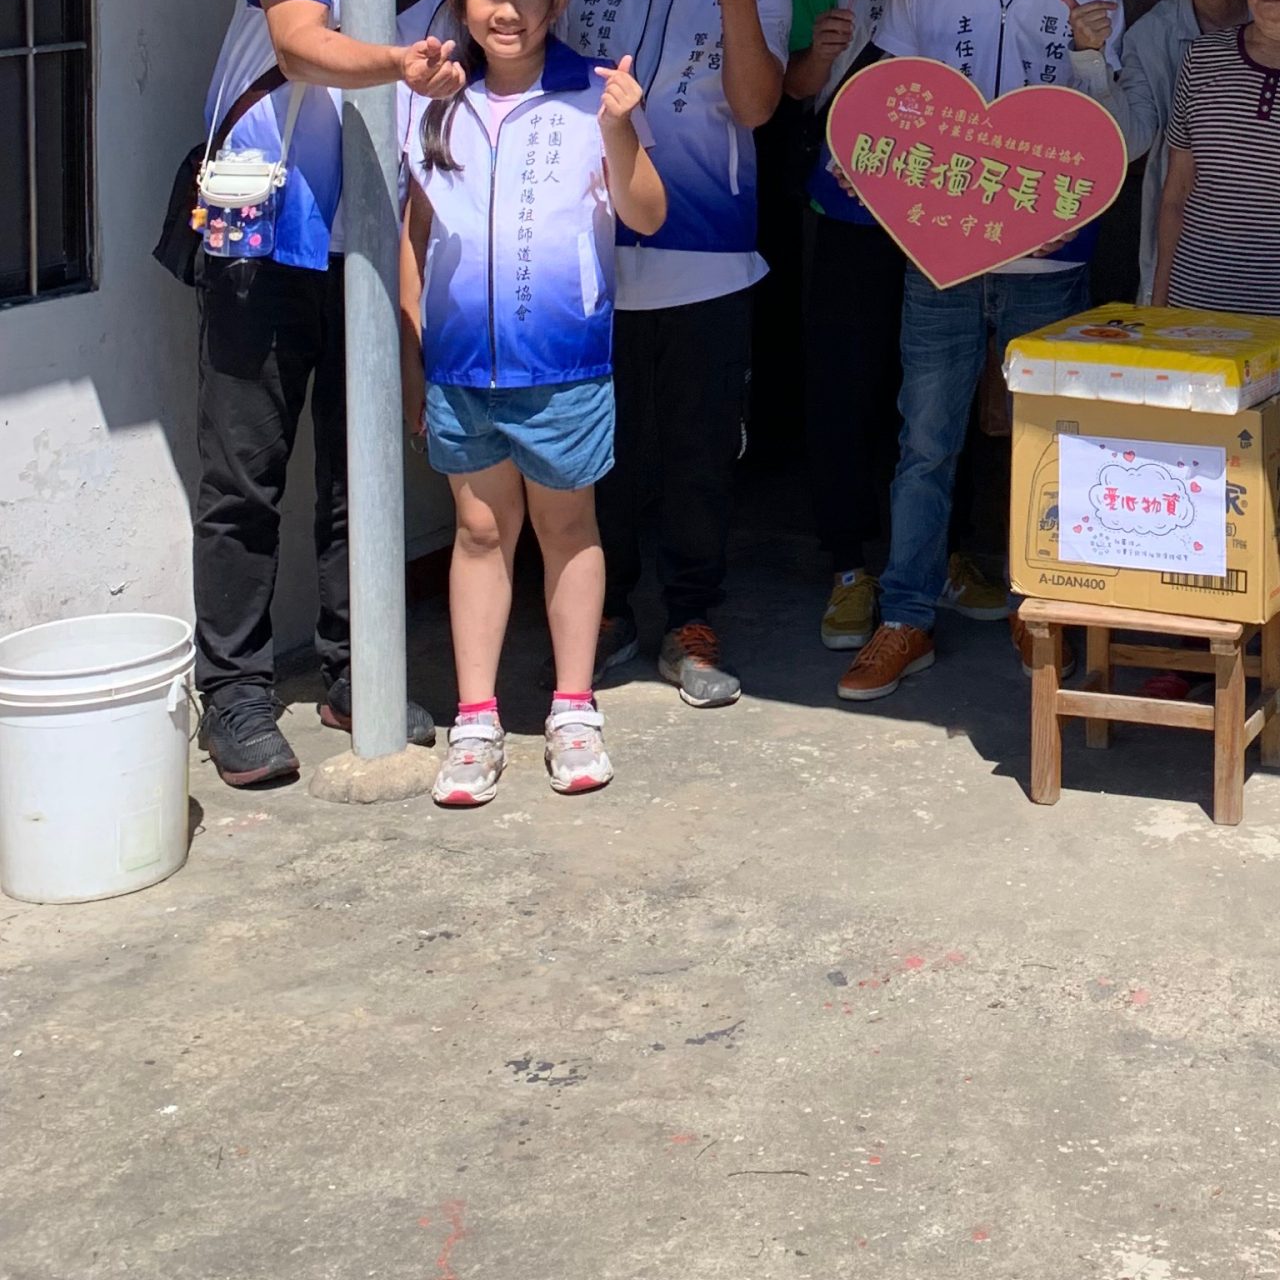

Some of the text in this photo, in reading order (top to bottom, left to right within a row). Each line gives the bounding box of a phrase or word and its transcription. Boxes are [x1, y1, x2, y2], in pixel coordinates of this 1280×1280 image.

[672, 32, 708, 113] 管理委員會
[941, 106, 993, 128] 社團法人
[543, 113, 566, 183] 社團法人
[851, 133, 1095, 221] 關懷獨居長輩
[514, 113, 543, 322] 中華呂純陽祖師道法協會
[907, 203, 1005, 245] 愛心守護
[1240, 440, 1252, 450] UP
[1038, 573, 1106, 591] A-LDAN400
